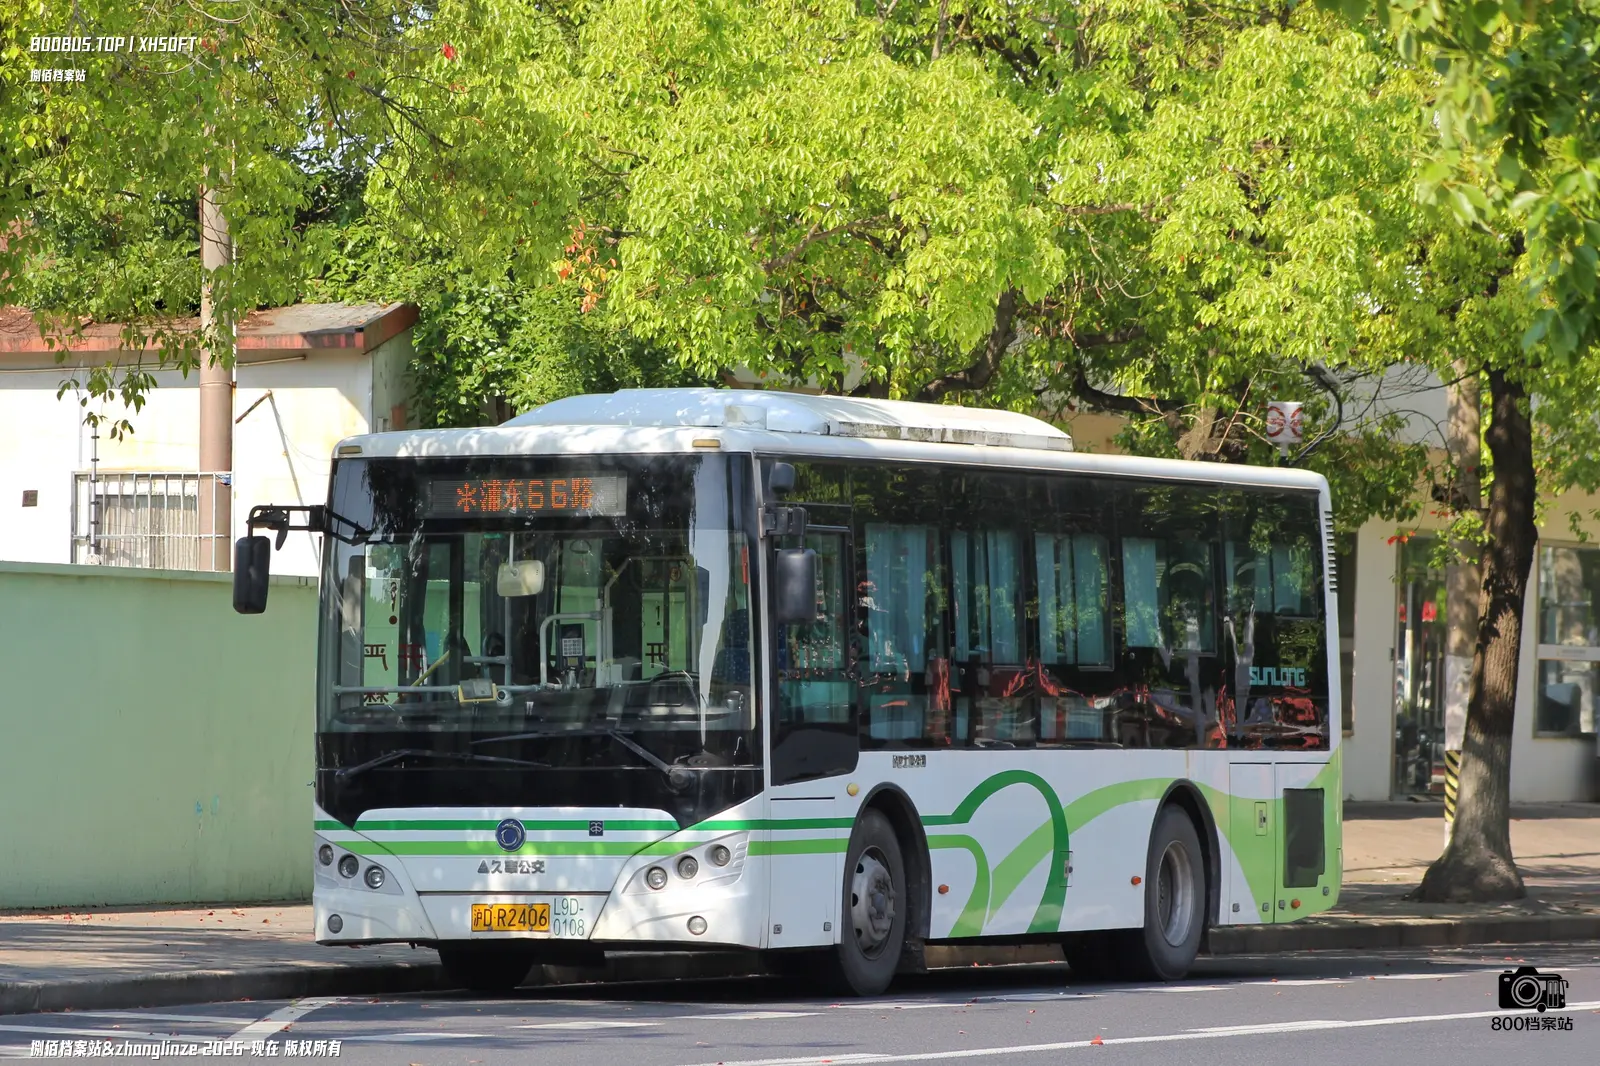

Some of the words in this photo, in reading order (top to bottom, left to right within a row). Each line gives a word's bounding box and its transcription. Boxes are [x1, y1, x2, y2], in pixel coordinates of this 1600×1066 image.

[1248, 666, 1306, 687] SUNLONG
[553, 898, 584, 916] L9D-
[553, 918, 585, 937] 0108
